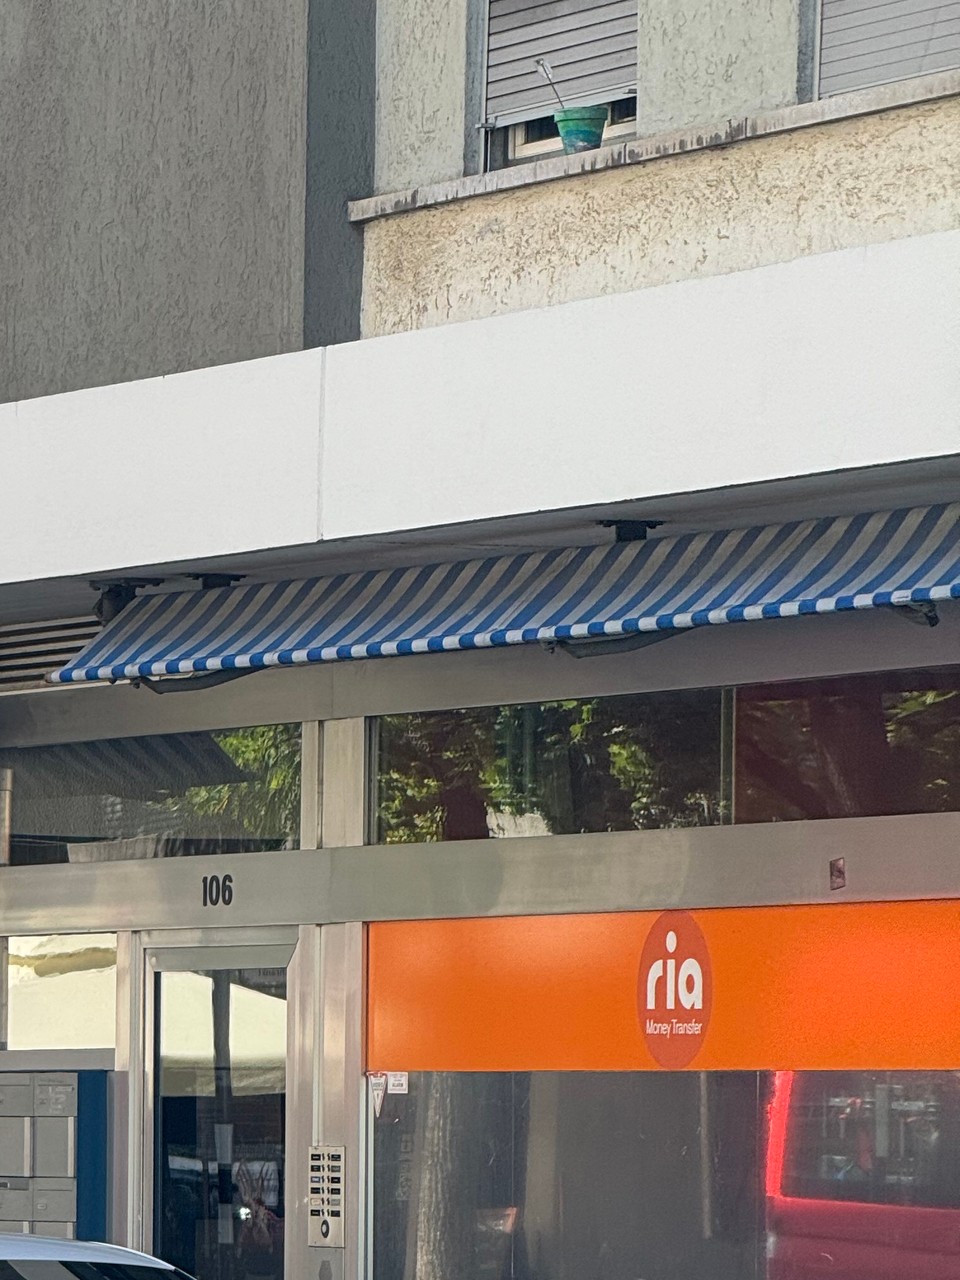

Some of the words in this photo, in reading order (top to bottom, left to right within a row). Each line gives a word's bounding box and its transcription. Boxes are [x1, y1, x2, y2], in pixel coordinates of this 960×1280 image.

[202, 874, 233, 907] 106
[646, 930, 703, 1010] ria
[645, 1019, 672, 1038] Money
[671, 1019, 702, 1034] Transfer
